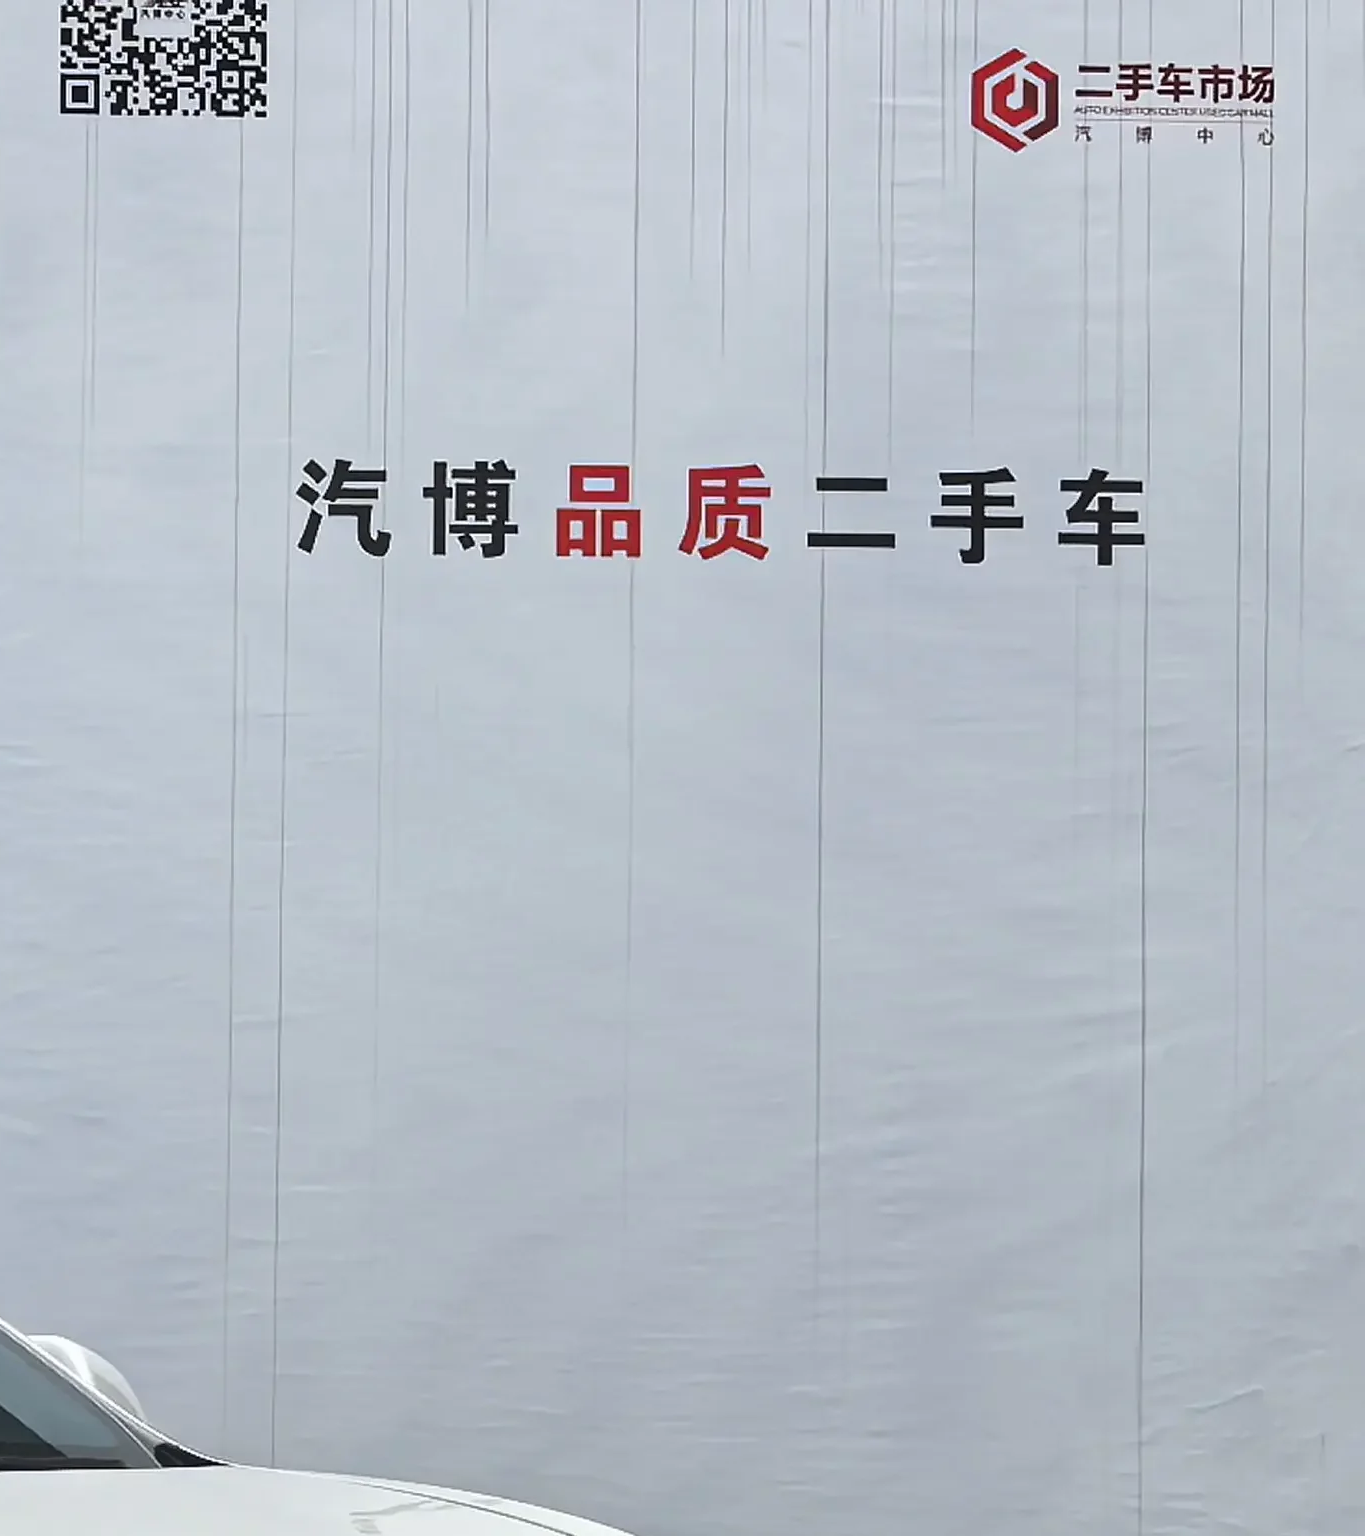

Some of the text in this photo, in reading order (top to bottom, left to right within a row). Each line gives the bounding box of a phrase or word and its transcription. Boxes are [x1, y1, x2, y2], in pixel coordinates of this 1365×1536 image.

[1075, 63, 1274, 103] 二手车市场
[1075, 126, 1274, 146] 汽博中心
[296, 459, 1147, 566] 汽博品质二手车
